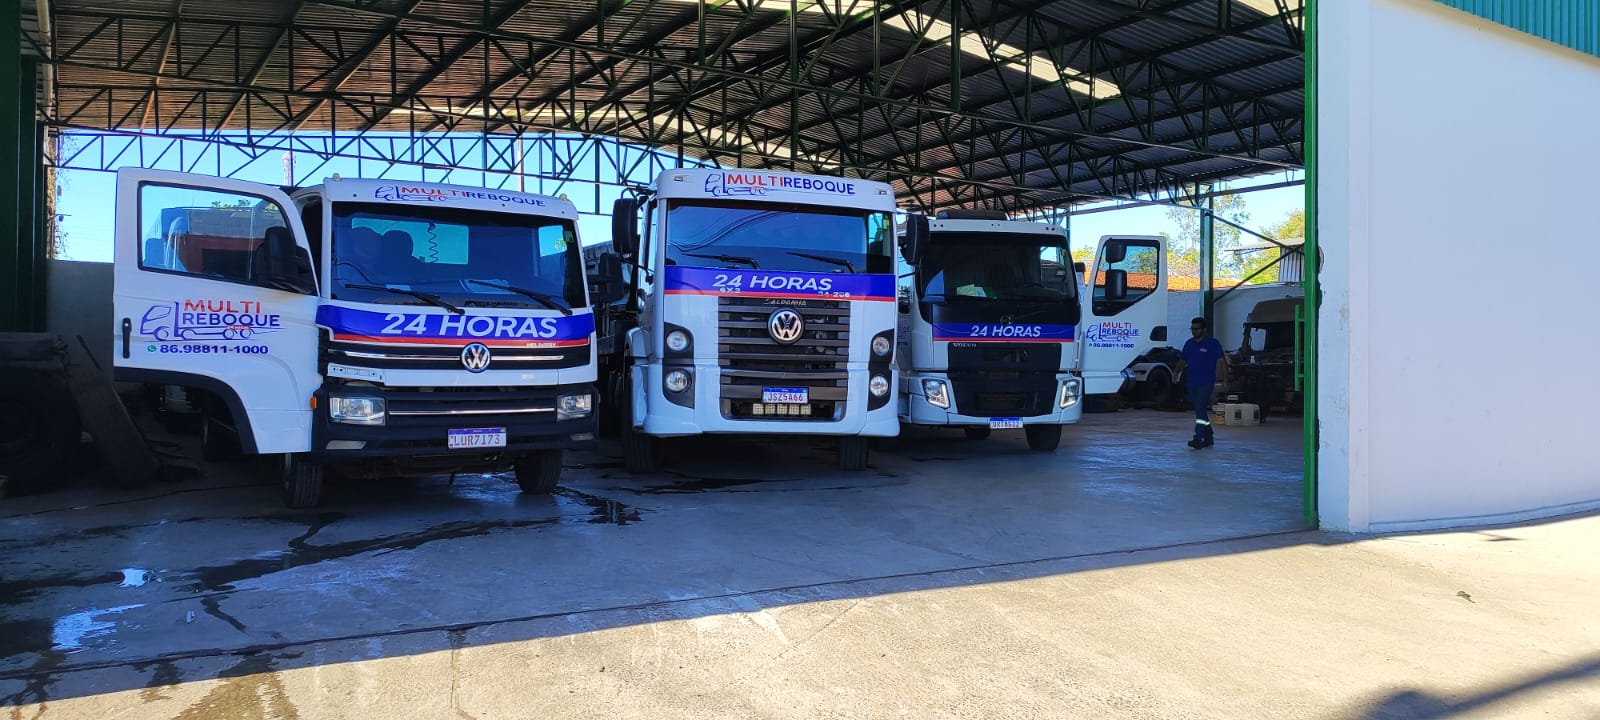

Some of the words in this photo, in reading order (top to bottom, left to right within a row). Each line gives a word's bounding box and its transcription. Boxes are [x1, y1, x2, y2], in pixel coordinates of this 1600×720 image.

[727, 173, 856, 195] MULTIREBOQUE
[401, 186, 546, 207] MULTIREBOQUE
[712, 274, 743, 288] 24
[750, 275, 833, 291] HORAS
[184, 299, 262, 314] MULTI
[182, 313, 281, 327] REBOQUE
[381, 312, 427, 335] 24
[438, 315, 558, 338] HORAS
[1102, 321, 1132, 329] MULTI
[970, 325, 988, 337] 24
[992, 325, 1042, 338] HORAS
[159, 344, 269, 355] 86.98811-1000
